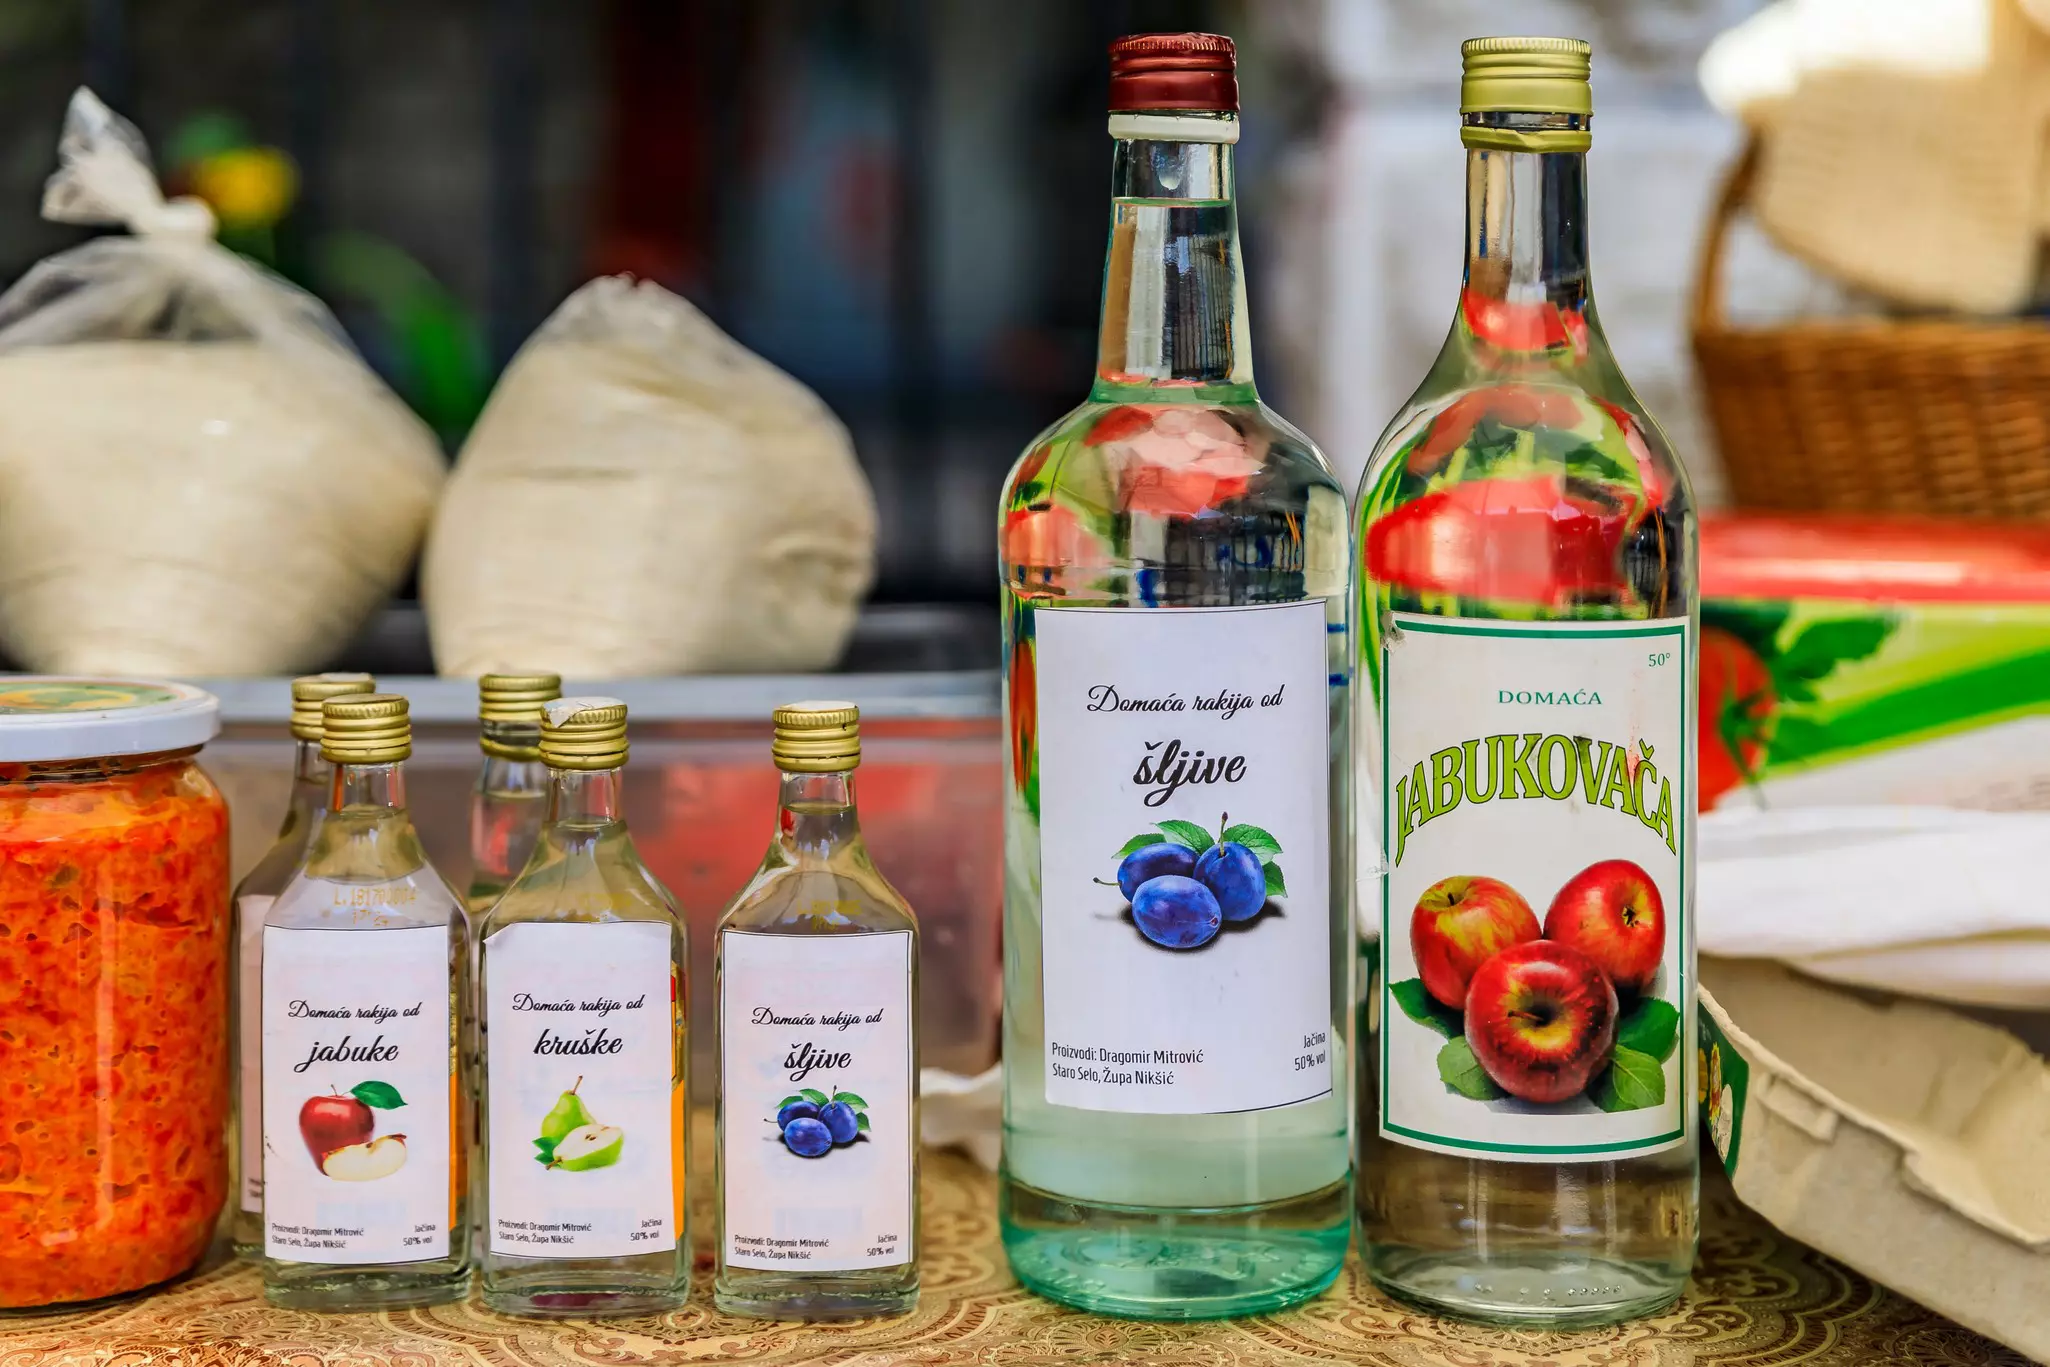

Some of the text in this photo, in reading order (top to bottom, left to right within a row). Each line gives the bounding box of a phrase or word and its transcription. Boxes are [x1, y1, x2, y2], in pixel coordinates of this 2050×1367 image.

[1086, 684, 1285, 720] Domaća rakija od
[1498, 688, 1603, 705] DOMAĆA
[1133, 739, 1247, 807] šljive
[1395, 732, 1677, 868] JABUKOVAČA
[288, 999, 423, 1024] Domaća rakija od
[512, 993, 645, 1017] Domaća rakija od
[751, 1006, 884, 1031] Domaća rakija od
[533, 1027, 623, 1055] kruške
[1304, 1031, 1326, 1049] Jačina
[293, 1034, 399, 1073] jabuke
[784, 1042, 852, 1082] šljive
[1052, 1042, 1204, 1065] Proizvodi: Dragomir Mitrović
[1294, 1050, 1326, 1072] 50% vol
[1052, 1064, 1174, 1087] Staro Selo, Župa Nikšić
[302, 1226, 332, 1238] Dragomir
[334, 1227, 364, 1237] Mitrović
[414, 1224, 436, 1234] Jačina
[530, 1223, 560, 1233] Dragomir
[562, 1223, 592, 1232] Mitrović
[641, 1219, 662, 1229] Jačina
[303, 1237, 321, 1250] Župa
[403, 1237, 422, 1247] 50%
[532, 1233, 549, 1244] Župa
[630, 1232, 649, 1242] 50%
[767, 1237, 798, 1248] Dragomir
[799, 1238, 829, 1248] Mitrović
[877, 1234, 897, 1244] Jačina
[768, 1249, 786, 1260] Župa
[787, 1250, 812, 1260] Nikšić
[867, 1247, 884, 1257] 50%
